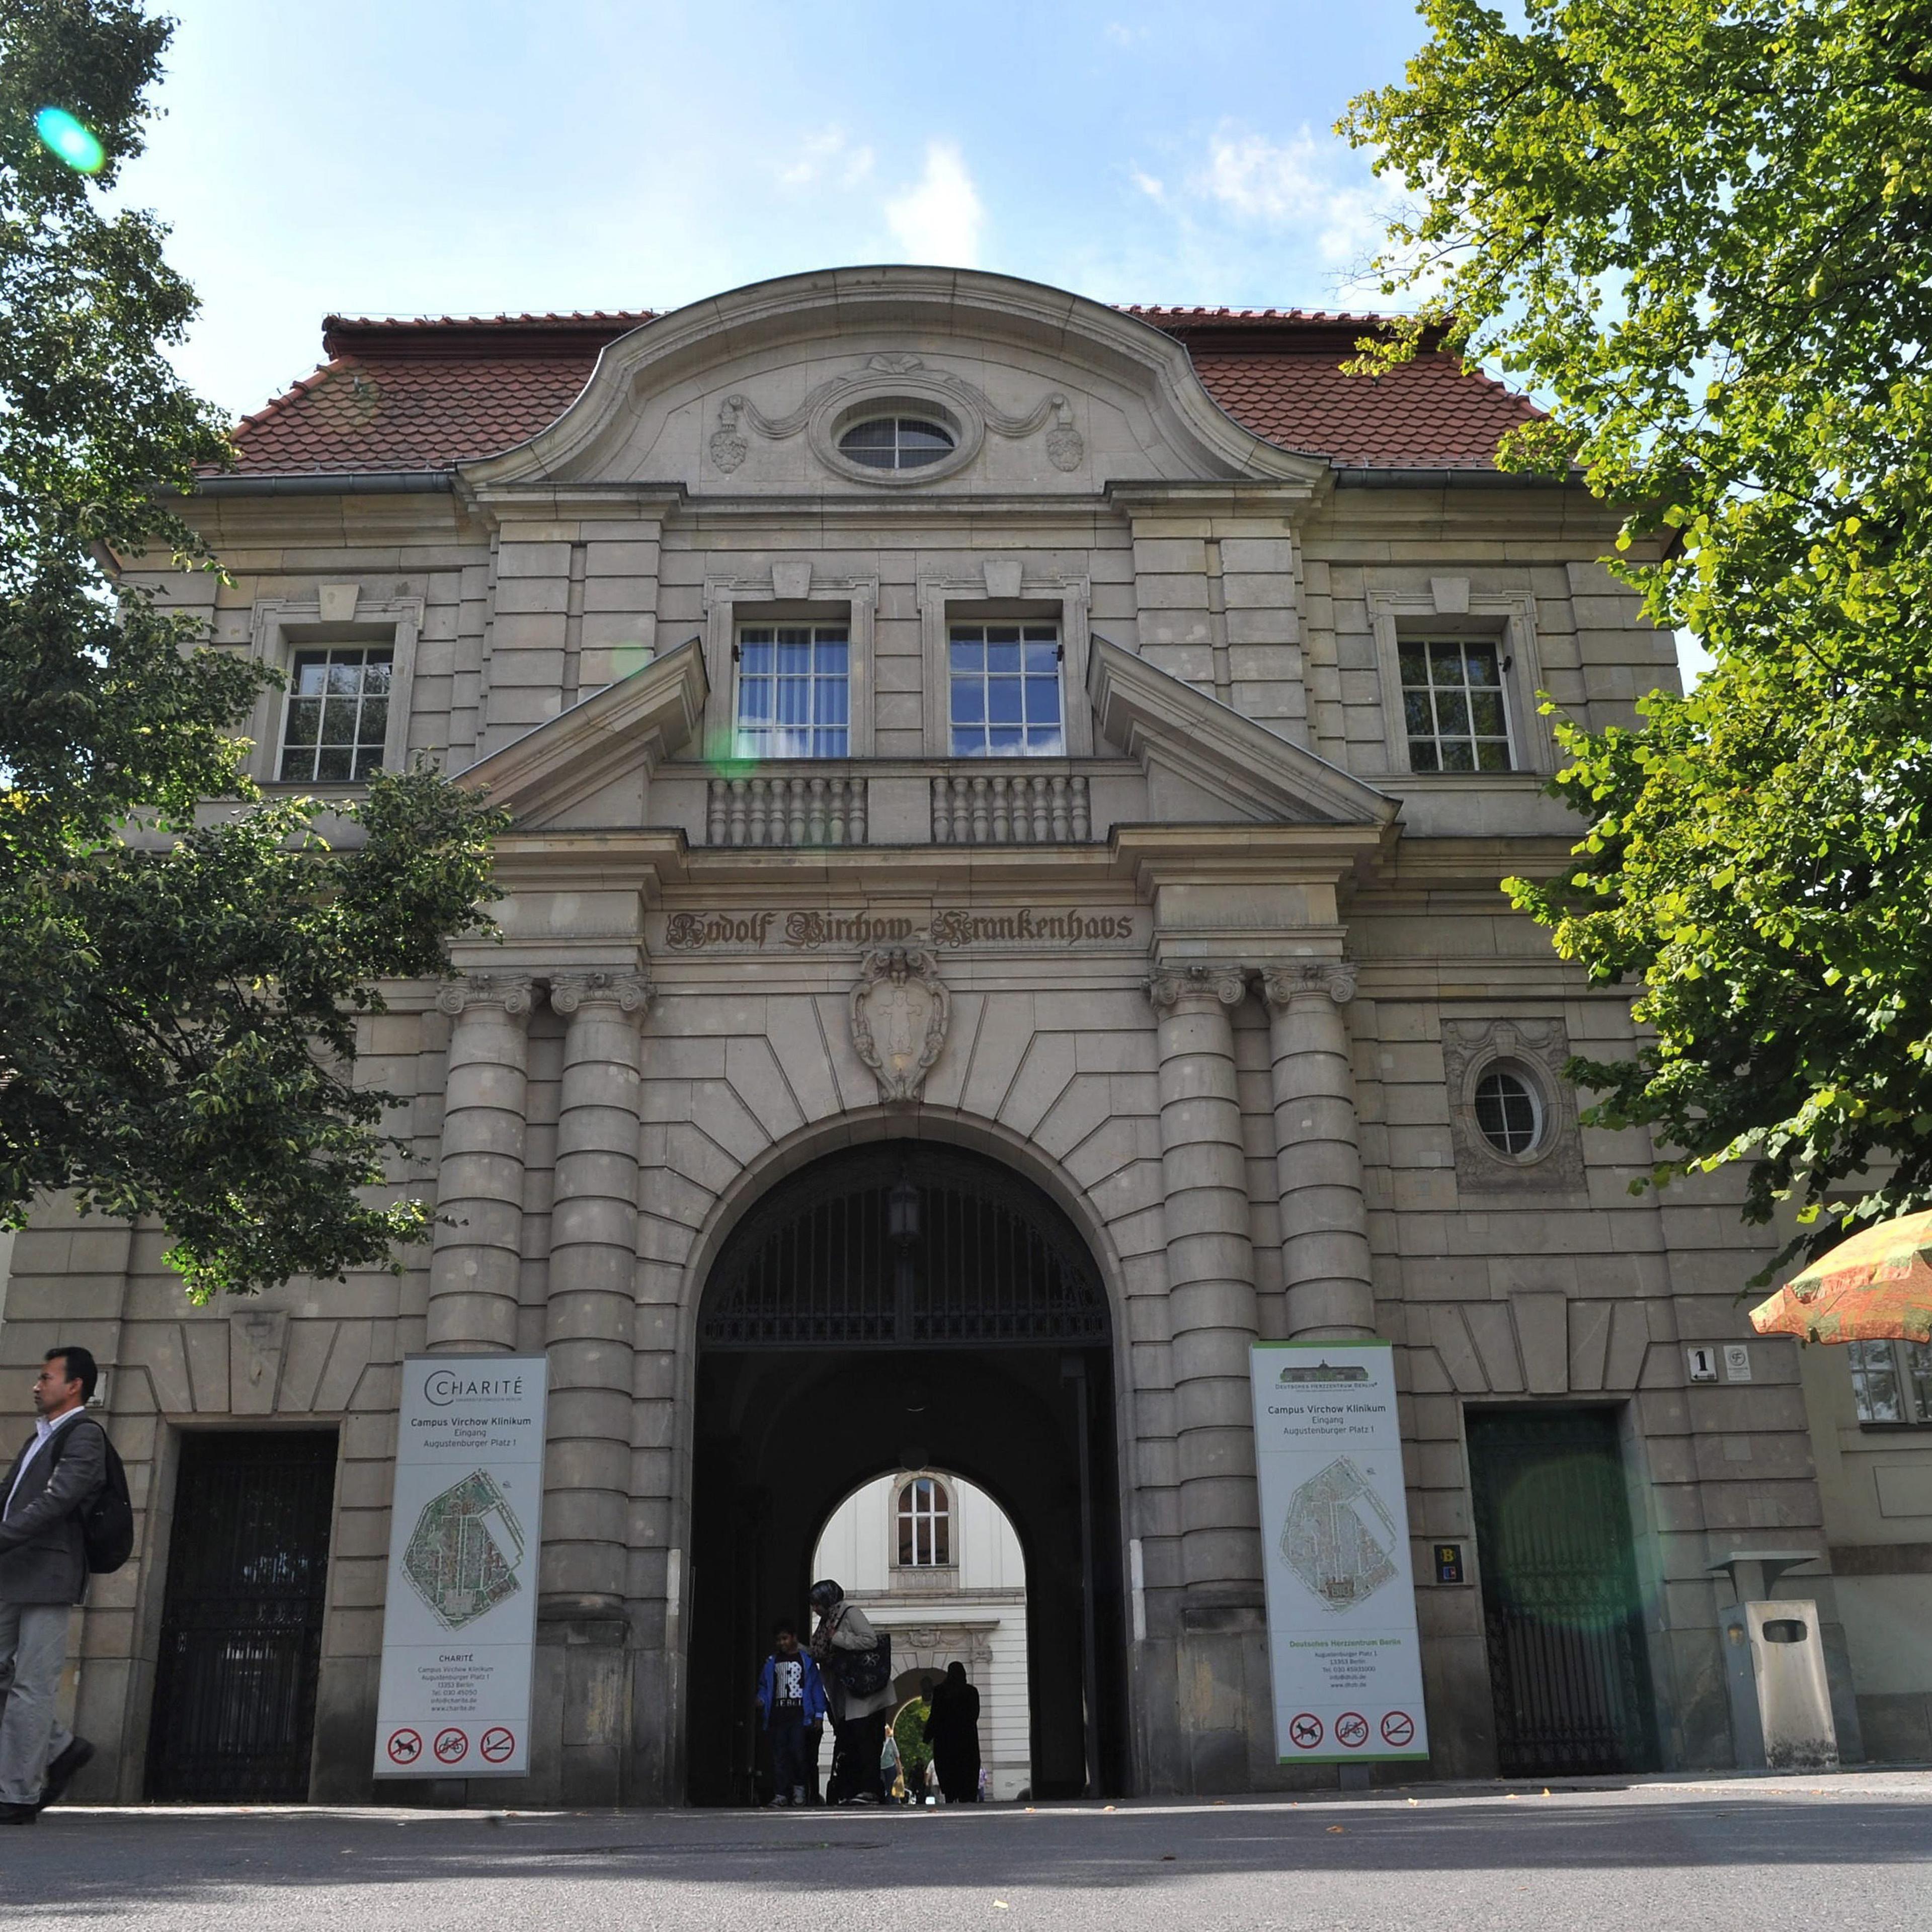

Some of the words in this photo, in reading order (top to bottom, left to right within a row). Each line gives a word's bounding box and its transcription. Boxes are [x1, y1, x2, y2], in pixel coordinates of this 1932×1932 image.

[665, 912, 777, 950] Rudolf
[1695, 1350, 1708, 1372] 1
[1268, 1406, 1304, 1415] Campus
[1307, 1405, 1343, 1413] Virchow
[1346, 1404, 1386, 1413] Klinikum
[411, 1418, 448, 1427] Campus
[451, 1417, 489, 1426] Virchow
[491, 1417, 531, 1425] Klinikum
[1312, 1416, 1344, 1425] Eingang
[454, 1429, 487, 1437] Eingang
[1283, 1427, 1346, 1435] Augustenburger
[424, 1439, 488, 1448] Augustenburger
[491, 1439, 511, 1447] Platz
[439, 1654, 473, 1662] CHARITÉ
